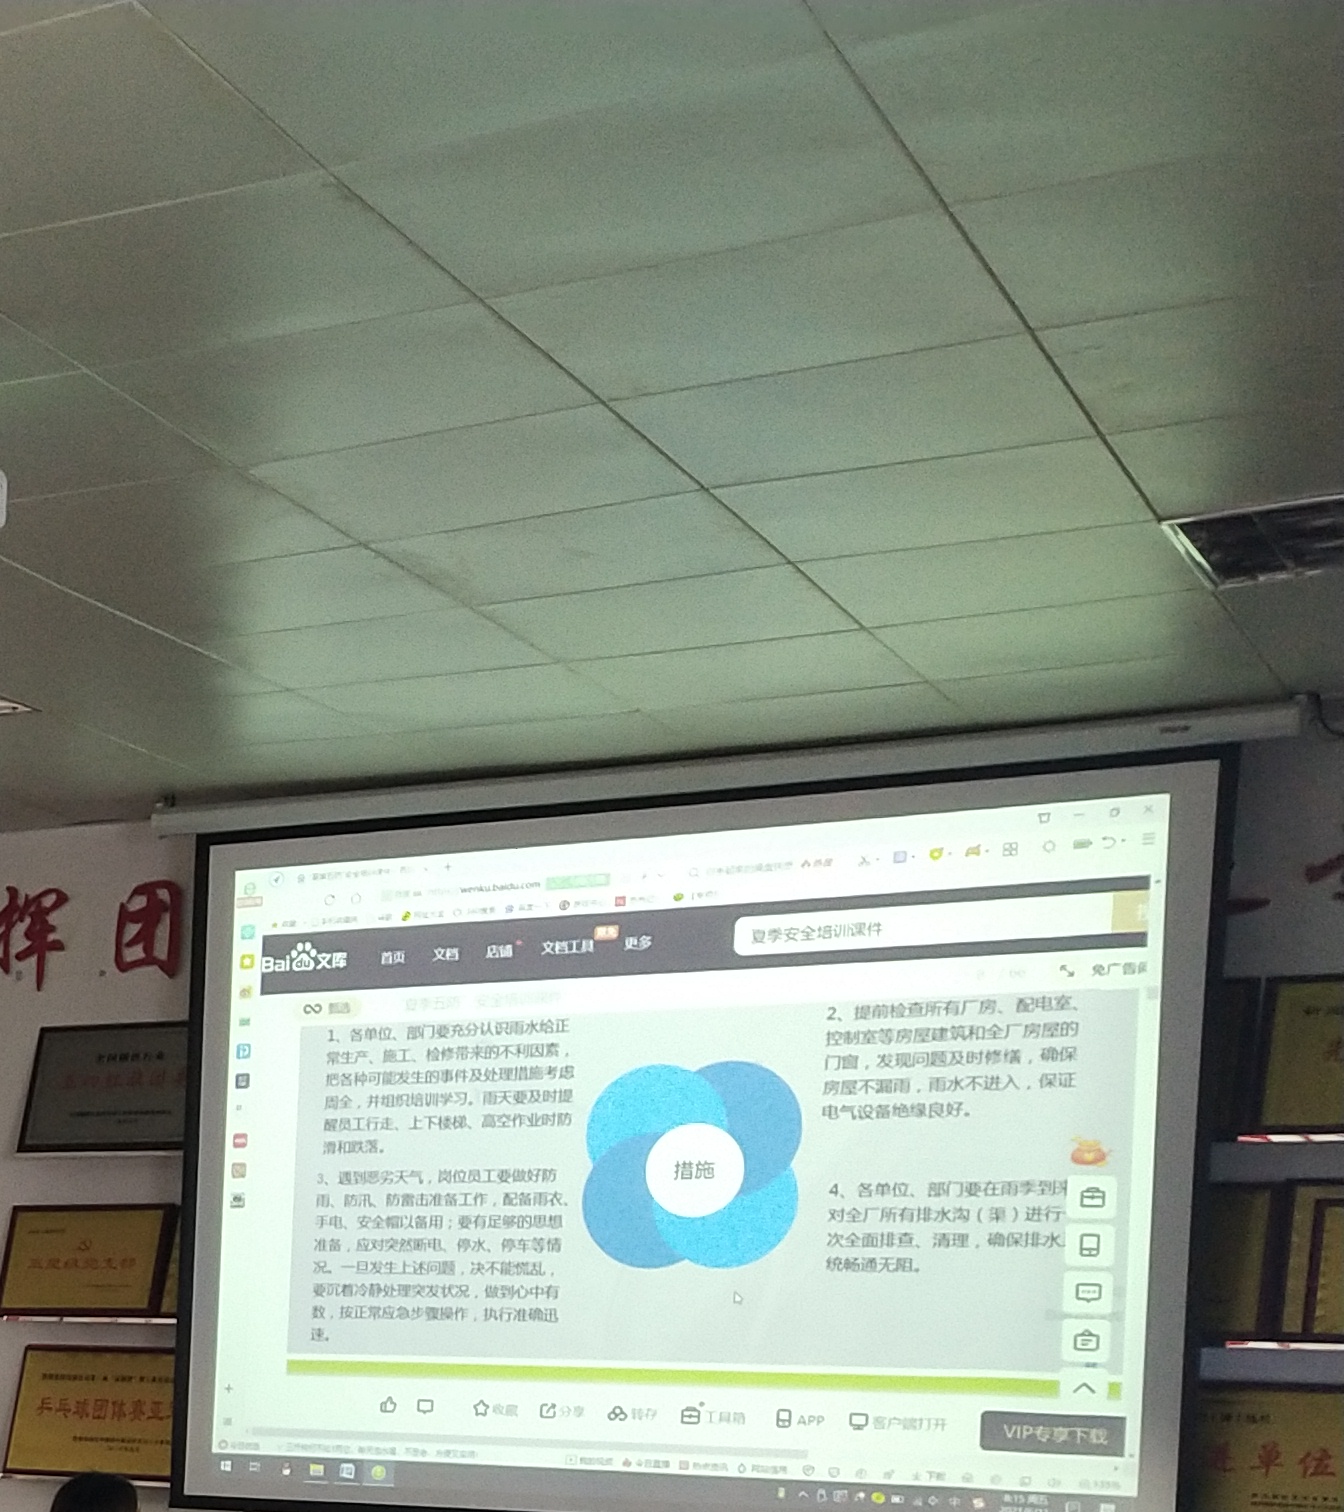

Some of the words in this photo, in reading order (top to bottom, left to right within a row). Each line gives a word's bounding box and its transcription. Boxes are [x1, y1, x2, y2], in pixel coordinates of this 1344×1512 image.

[541, 938, 594, 956] 文档工具
[624, 935, 652, 951] 更多
[381, 950, 405, 965] 首页
[432, 947, 459, 962] 文档
[485, 944, 513, 960] 店铺
[825, 1021, 1079, 1047] 控制室等房屋建筑和全厂房屋的
[325, 1065, 575, 1088] 把各种可能发生的事件及处理措施考虑
[821, 1102, 972, 1121] 电气设备绝缘良好。
[322, 1139, 385, 1155] 滑和跌落。
[674, 1160, 715, 1180] 措施
[827, 1205, 1067, 1224] 对全厂所有排水沟（渠）进行
[826, 1231, 1066, 1250] 次全面排查、清理，确保排水
[826, 1257, 920, 1274] 统畅通无阻。
[36, 1397, 173, 1421] 乒乓球团体赛亚
[558, 1405, 585, 1418] 分享
[797, 1415, 825, 1427] APP
[873, 1416, 947, 1432] 客户端打开
[1004, 1423, 1109, 1445] VIP专享下载
